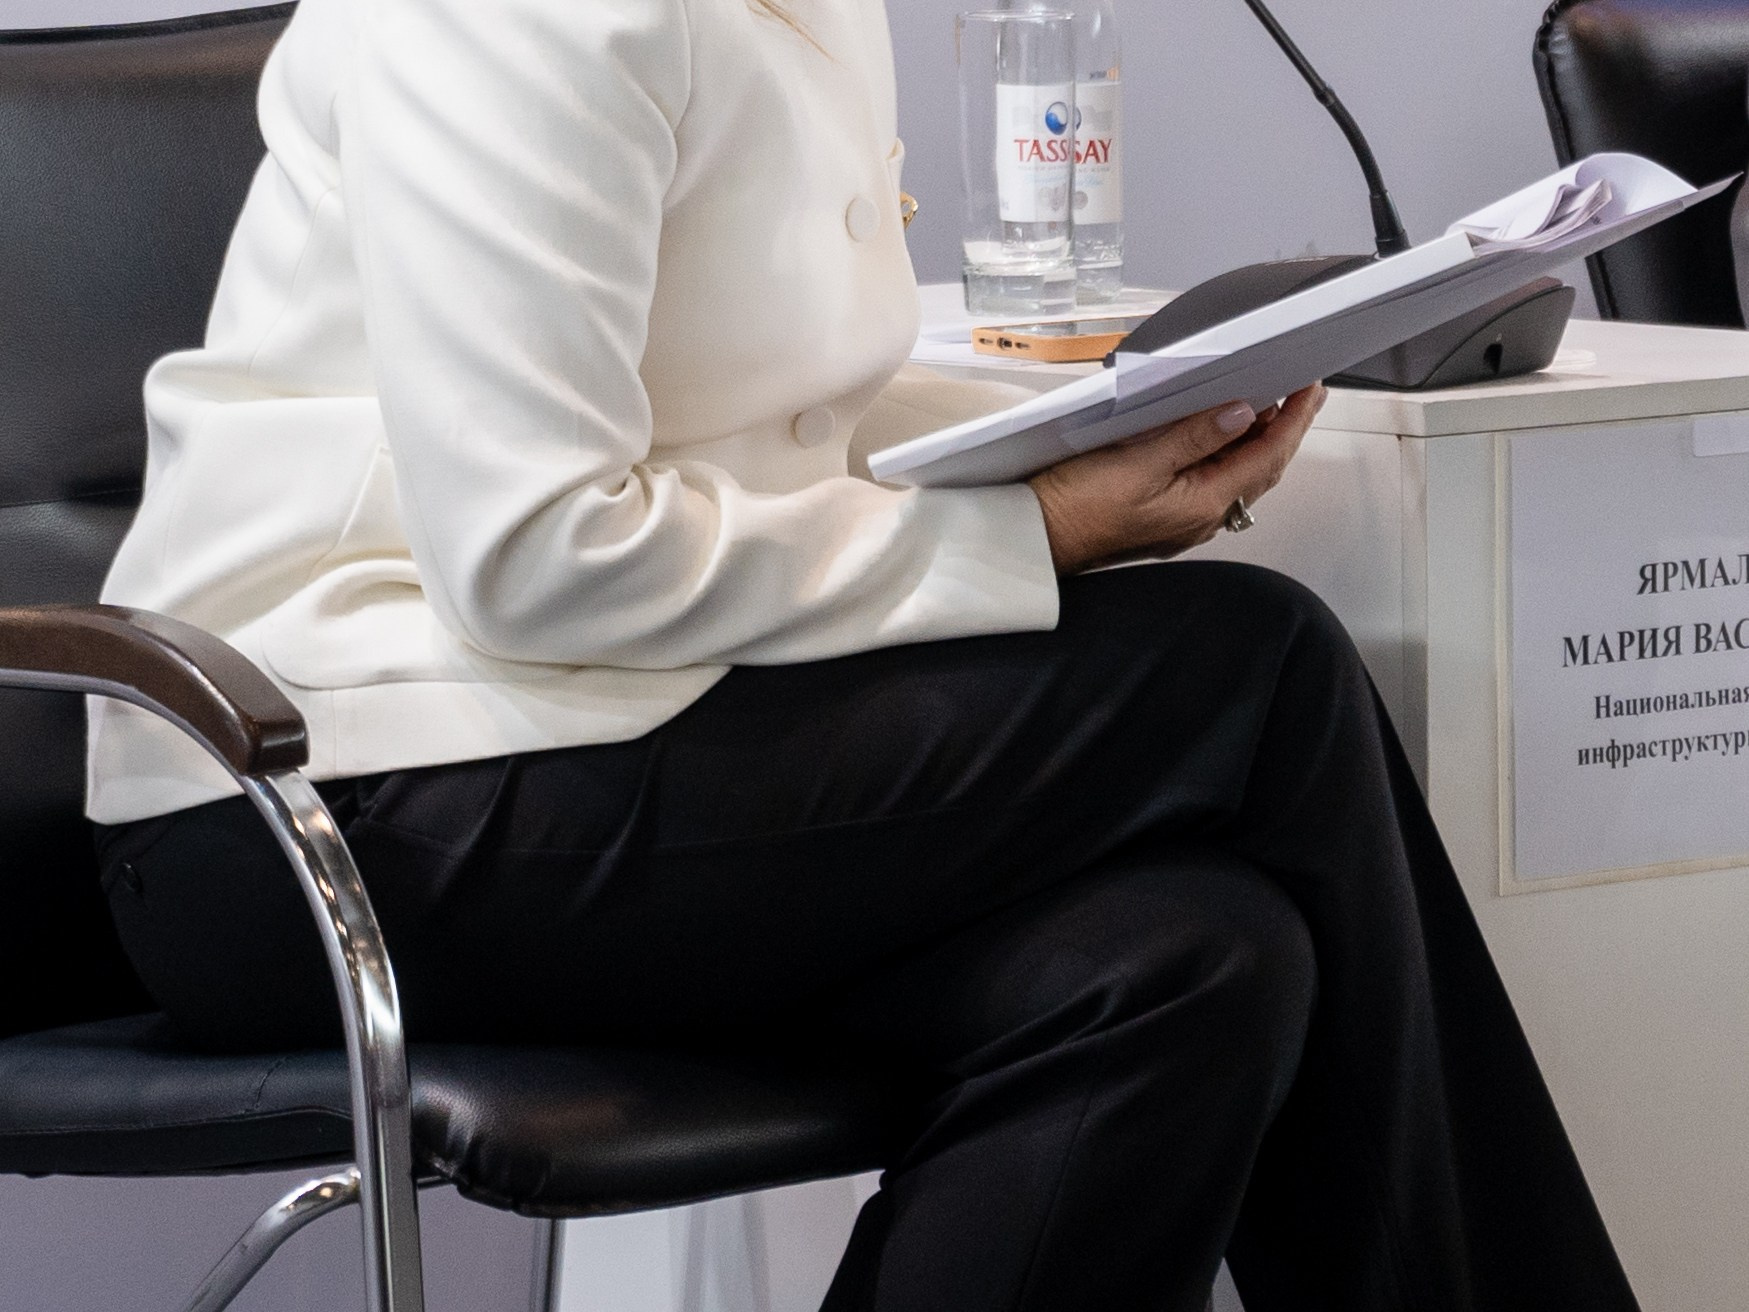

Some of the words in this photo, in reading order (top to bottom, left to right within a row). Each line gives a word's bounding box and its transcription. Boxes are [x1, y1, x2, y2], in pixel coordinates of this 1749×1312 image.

[1563, 625, 1682, 668] МАРИЯ
[1694, 618, 1749, 655] ВАС
[1578, 730, 1749, 769] инфраструктур
